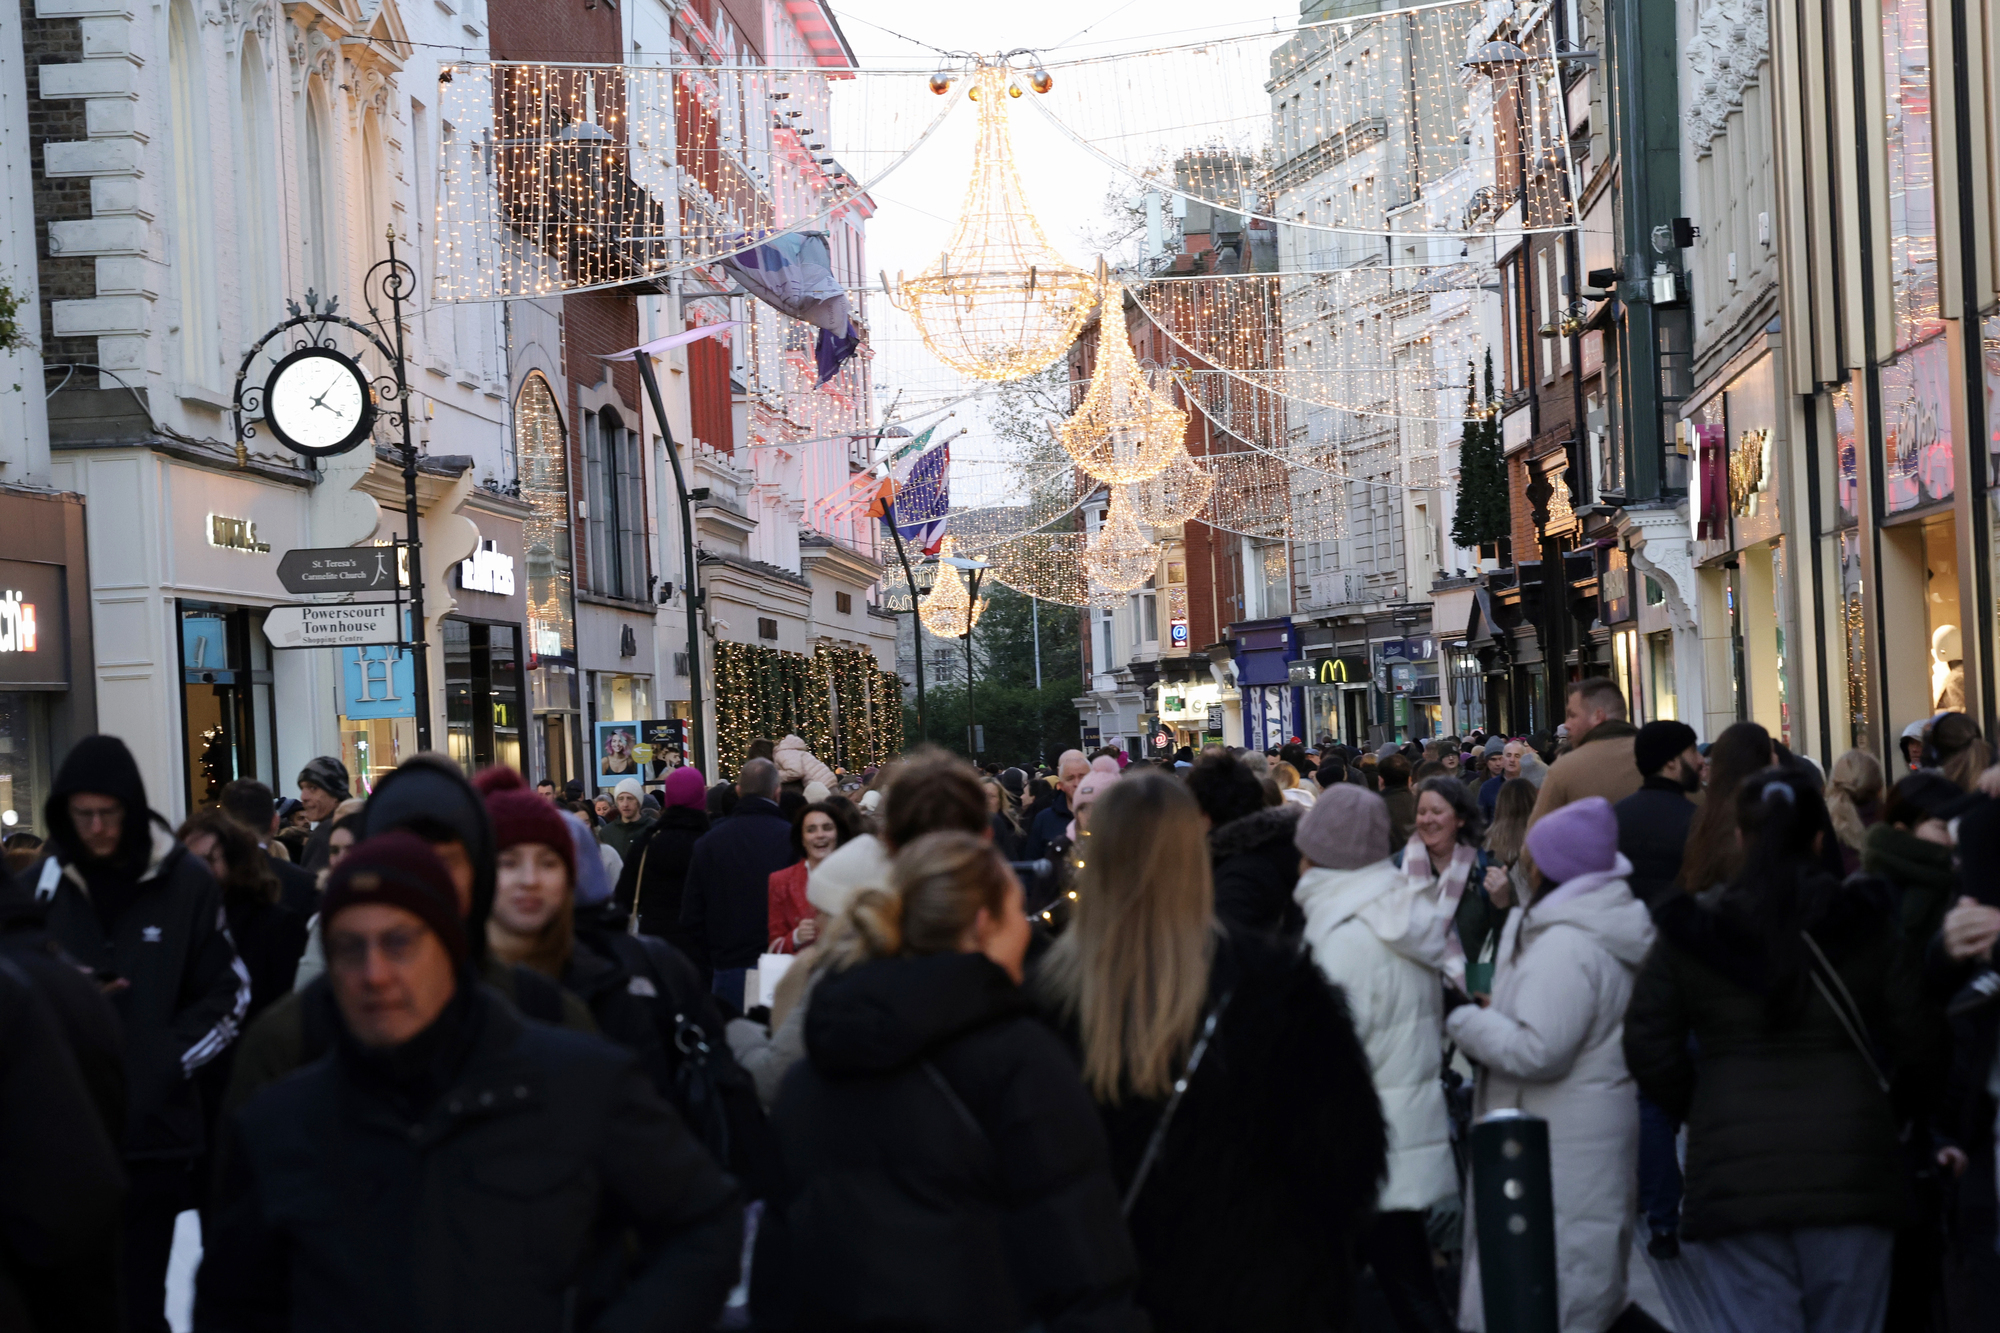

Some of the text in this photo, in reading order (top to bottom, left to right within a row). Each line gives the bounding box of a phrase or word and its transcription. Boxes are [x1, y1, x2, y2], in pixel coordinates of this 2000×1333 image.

[325, 559, 357, 568] Teresa's
[301, 571, 367, 581] Carmelite Church
[302, 606, 385, 620] Powerscourt
[302, 621, 377, 634] Townhouse
[302, 635, 364, 645] Shopping Centre
